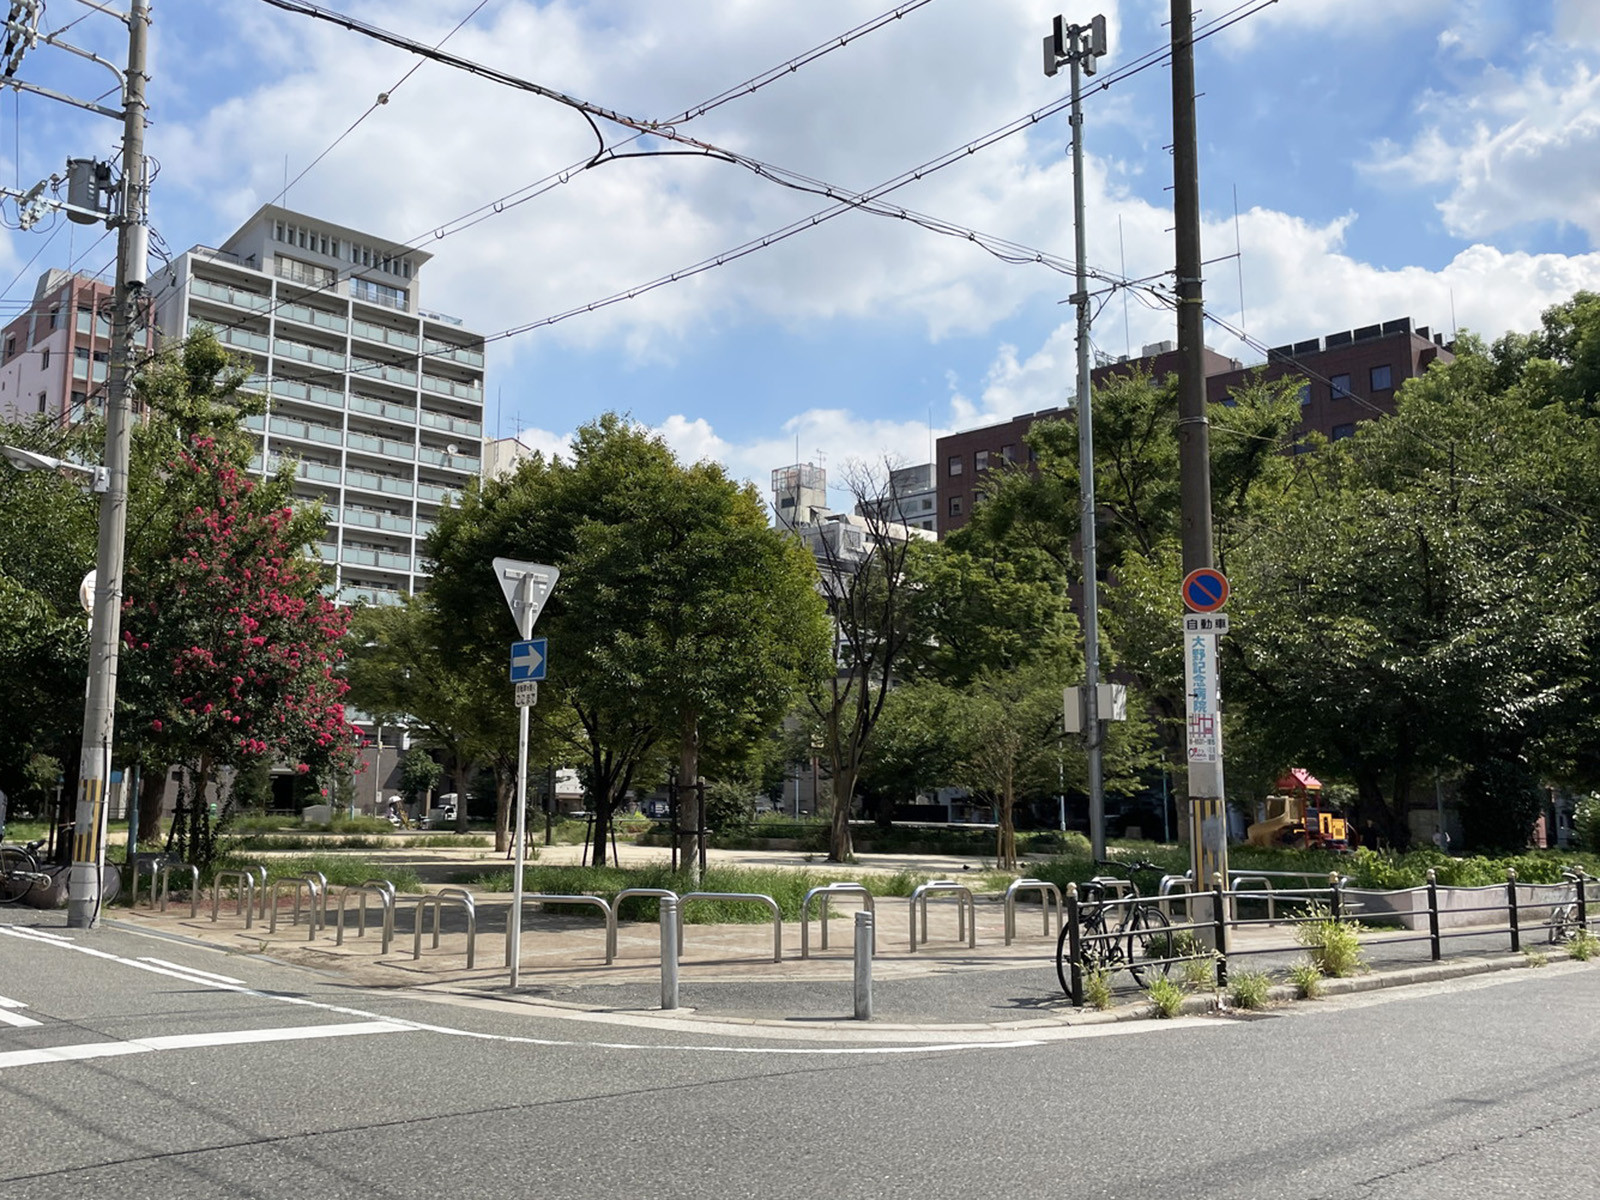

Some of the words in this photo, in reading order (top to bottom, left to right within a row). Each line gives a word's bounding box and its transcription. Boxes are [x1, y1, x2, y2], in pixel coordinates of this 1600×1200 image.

[1186, 618, 1227, 630] 自動車
[1192, 635, 1207, 713] 大野記念病院
